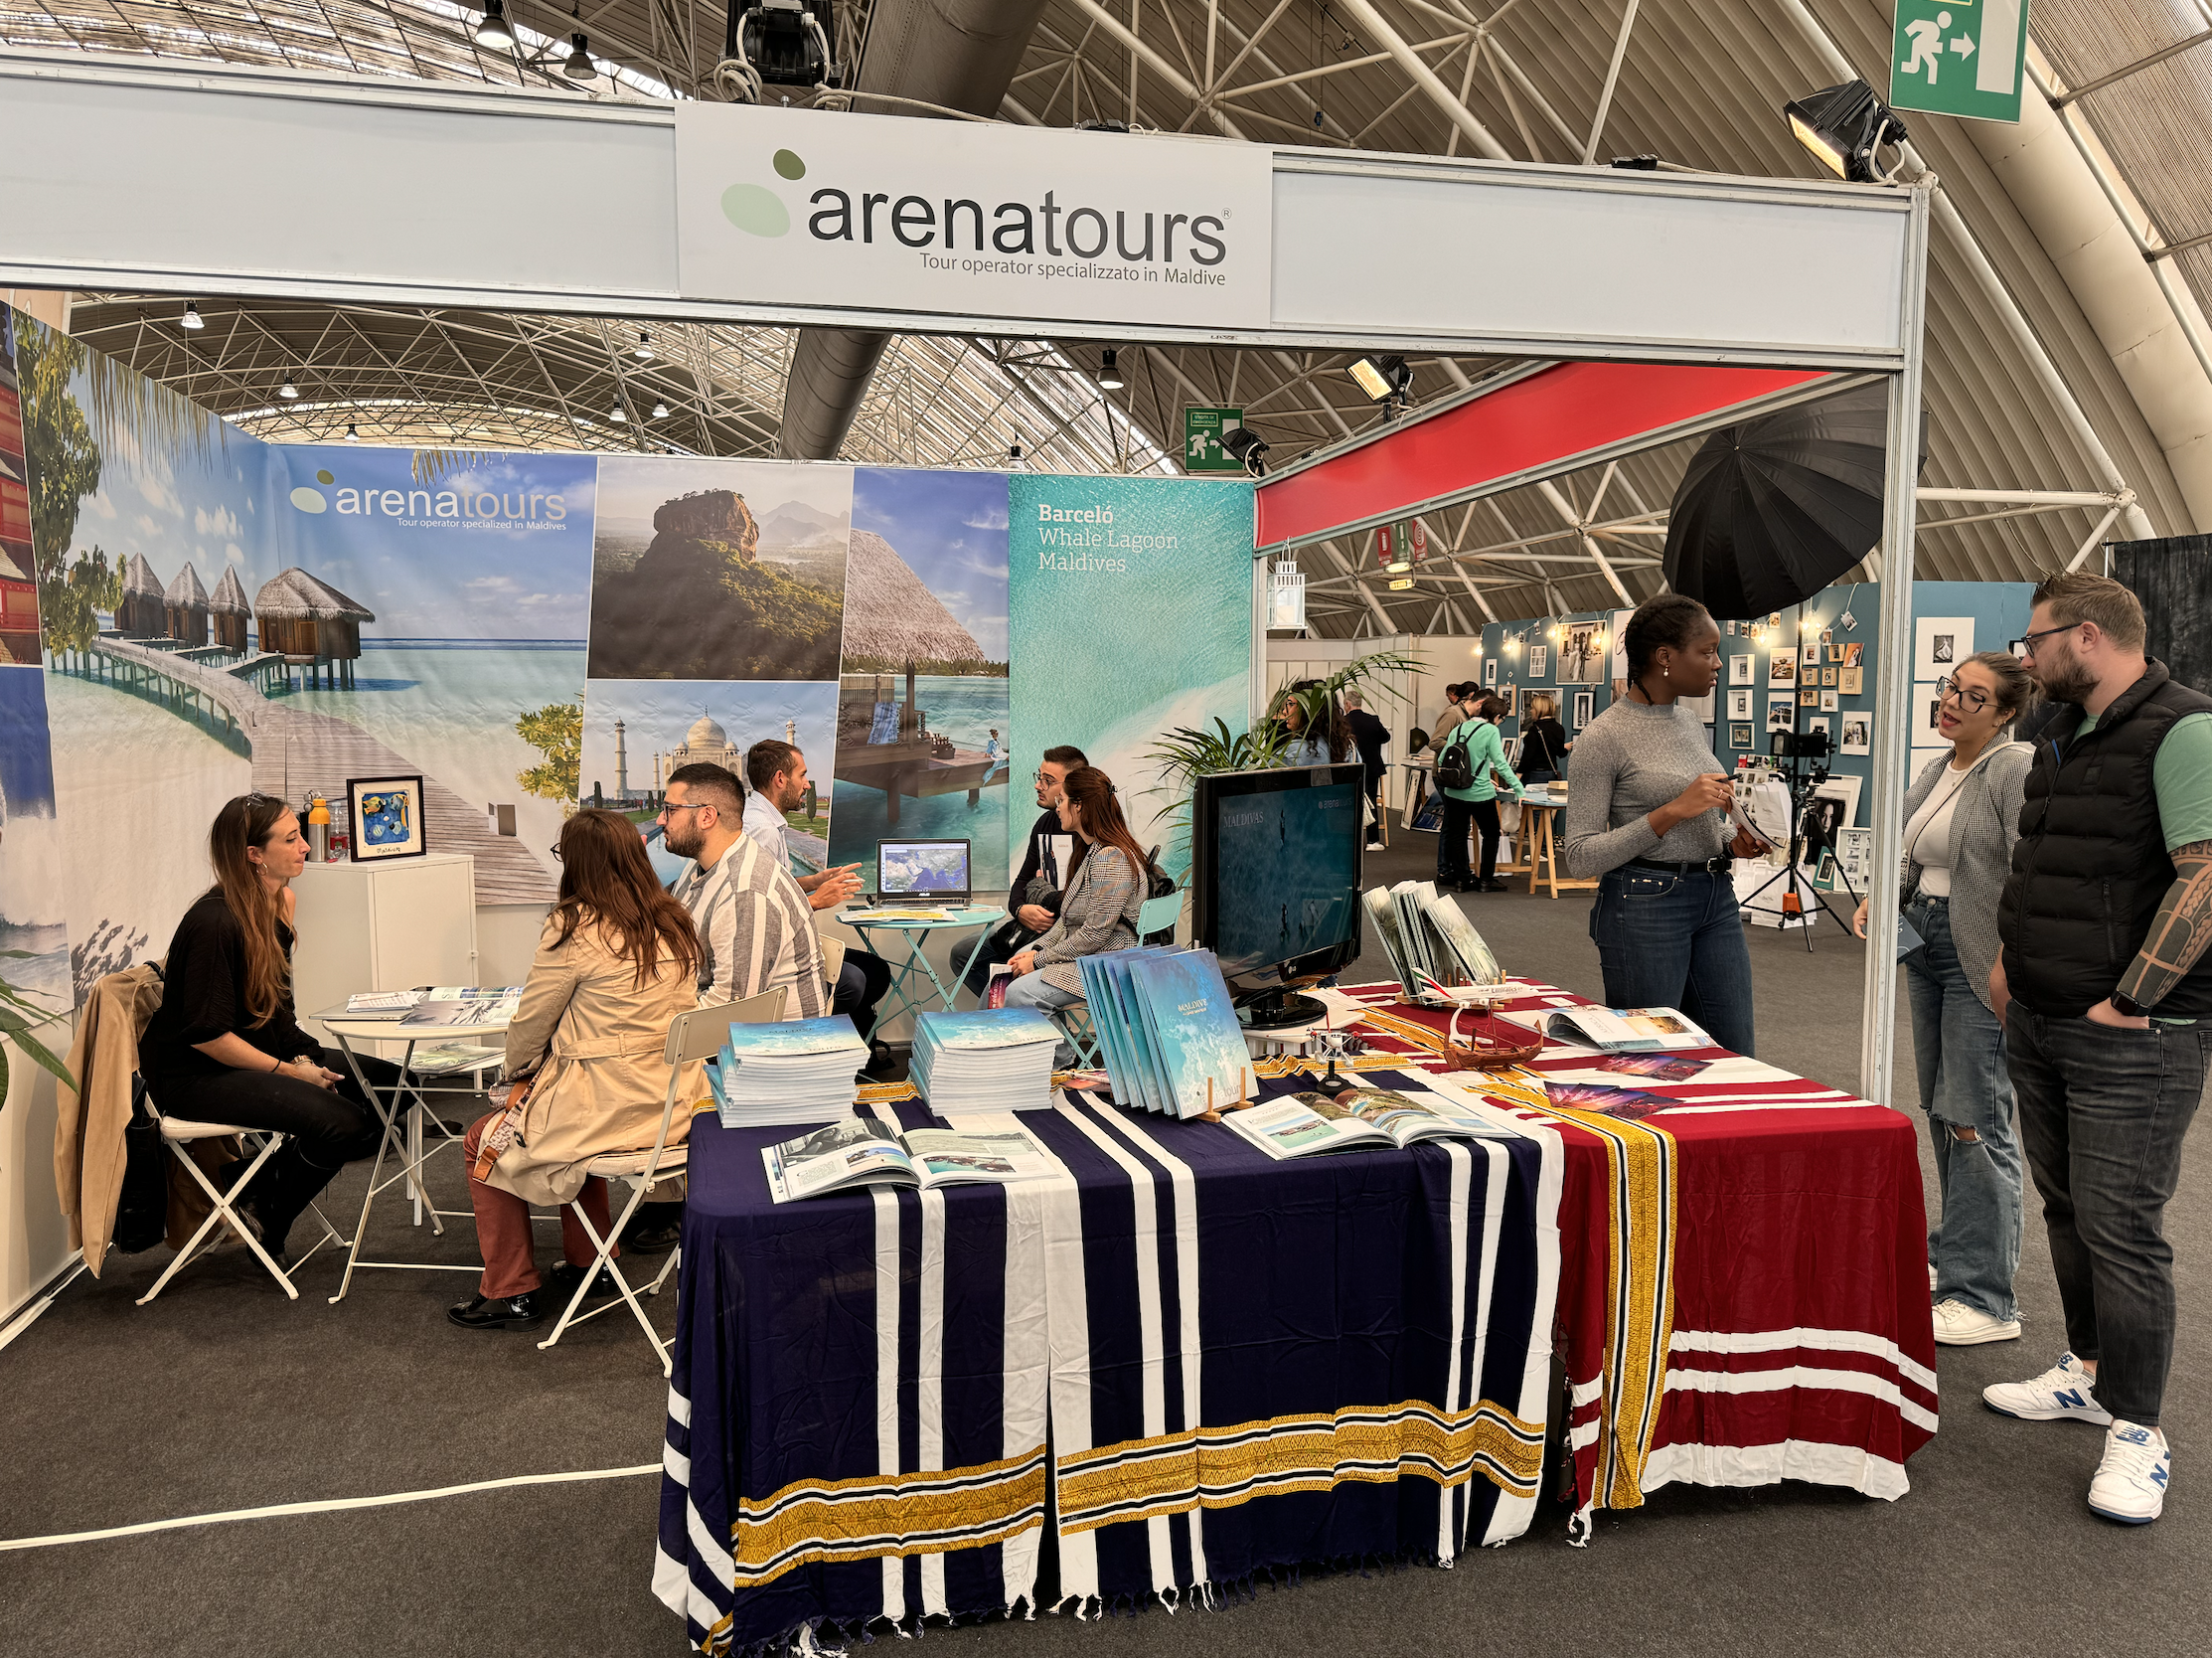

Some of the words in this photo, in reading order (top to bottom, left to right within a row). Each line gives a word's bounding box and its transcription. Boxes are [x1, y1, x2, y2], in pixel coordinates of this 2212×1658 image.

[919, 252, 958, 270] Tour
[961, 255, 1033, 275] operator
[1037, 260, 1140, 282] specializzato
[1144, 267, 1159, 282] in
[1165, 267, 1226, 286] Maldive
[336, 485, 567, 521] arenatours
[397, 517, 418, 528] Tour
[419, 519, 460, 530] operator
[462, 519, 512, 530] specialized
[515, 520, 524, 530] in
[526, 521, 567, 531] Maldives
[1038, 504, 1114, 524] Barceló
[1038, 528, 1102, 547] Whale
[1107, 530, 1179, 553] Lagoon
[1038, 553, 1126, 573] Maldives
[1223, 811, 1264, 829] MALDIVAS
[1178, 998, 1207, 1012] MALDIVE
